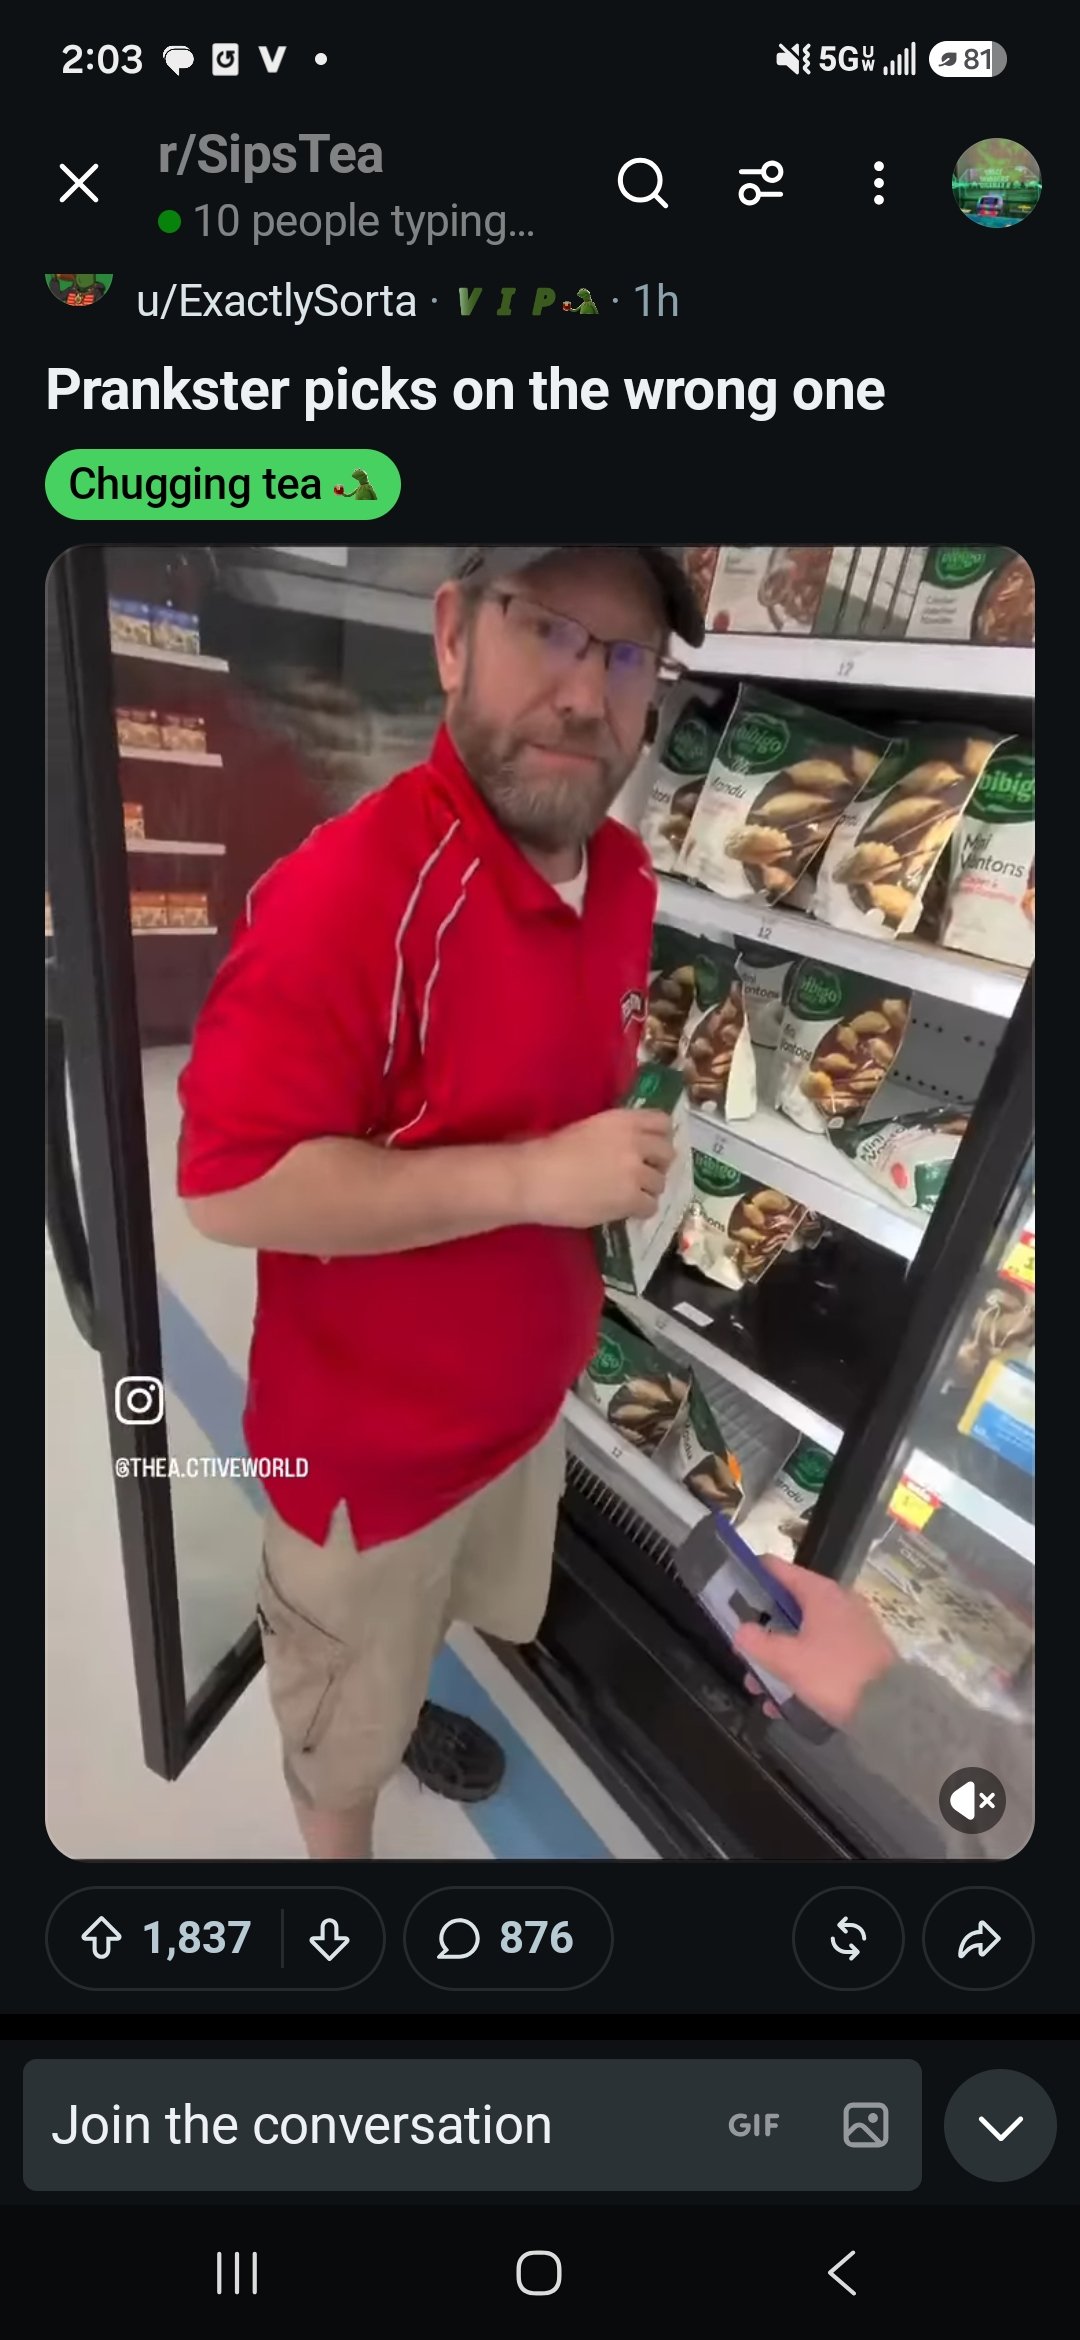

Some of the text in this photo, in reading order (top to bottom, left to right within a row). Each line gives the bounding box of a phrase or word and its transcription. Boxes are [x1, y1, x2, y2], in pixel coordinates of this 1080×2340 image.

[62, 44, 142, 74] 2:03
[964, 48, 991, 70] 81
[160, 133, 383, 183] r/SipsTea
[195, 204, 239, 236] 10
[254, 202, 379, 245] people
[138, 282, 416, 325] u/ExactlySorta
[635, 283, 678, 316] 1h
[48, 366, 885, 421] Prankster picks on the wrong one
[69, 466, 321, 508] Chugging tea
[978, 770, 1035, 803] bibig
[144, 1921, 251, 1961] 1,837
[501, 1921, 573, 1953] 876
[52, 2103, 550, 2144] Join the conversation
[729, 2113, 779, 2137] GIF
